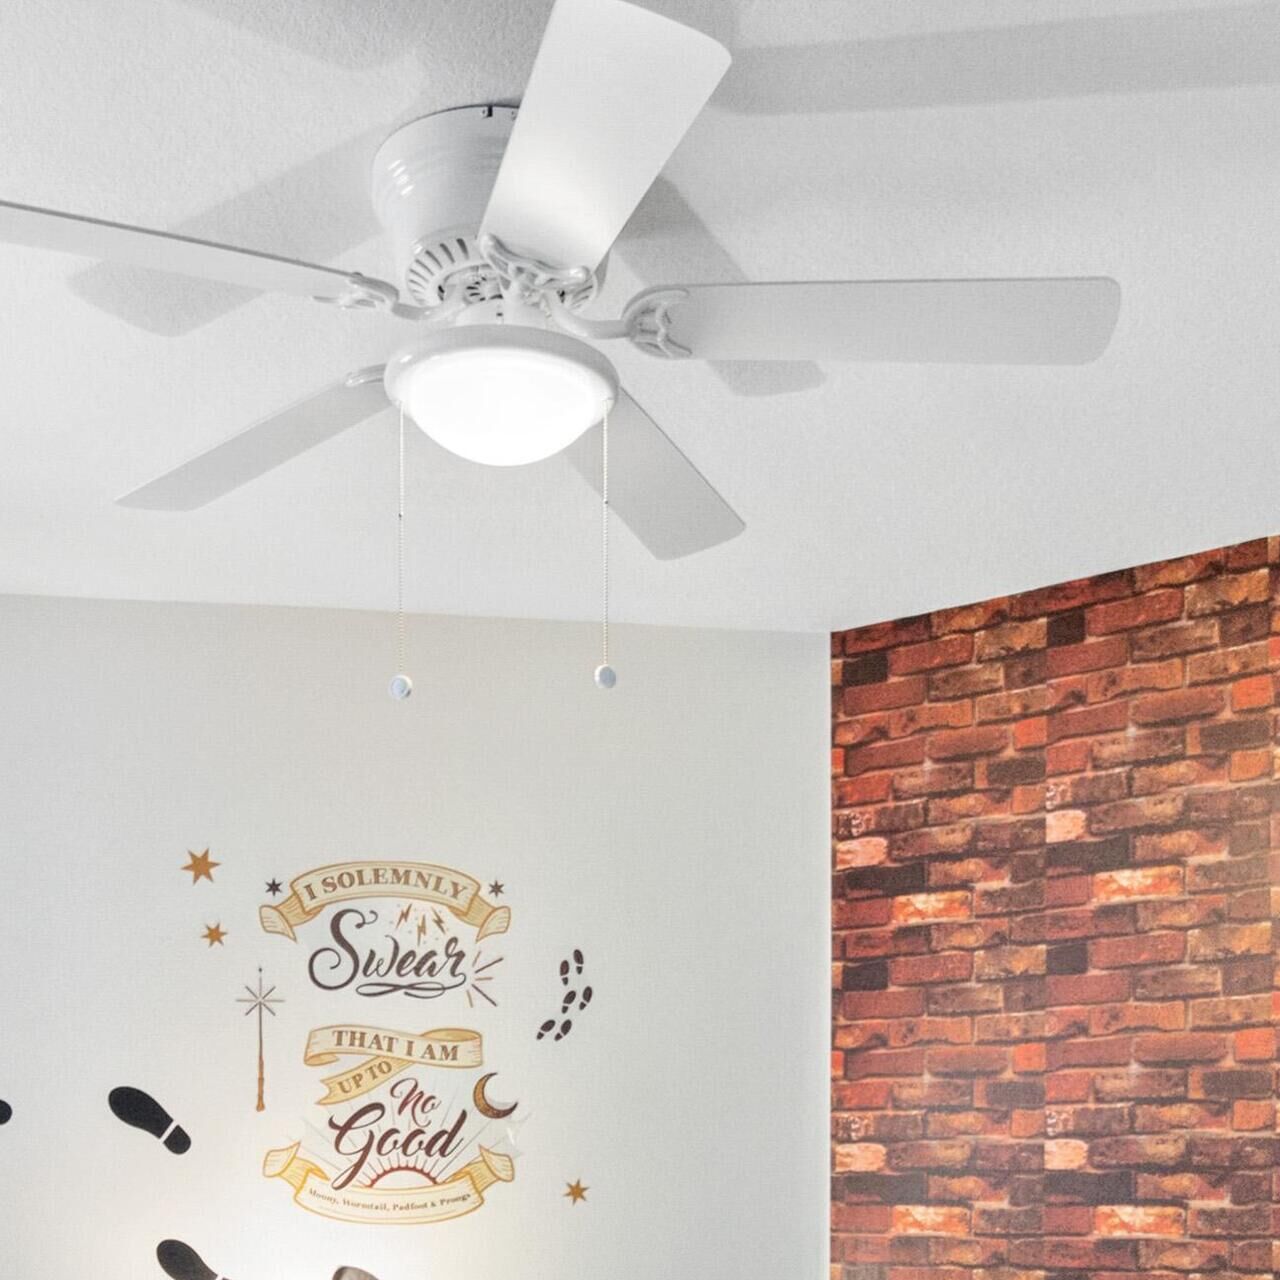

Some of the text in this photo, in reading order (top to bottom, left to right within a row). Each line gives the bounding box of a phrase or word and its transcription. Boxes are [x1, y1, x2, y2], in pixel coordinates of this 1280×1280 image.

[304, 867, 468, 901] I SOLEMNLY
[308, 908, 467, 999] Swear
[332, 1030, 460, 1062] THAT I AM
[337, 1060, 393, 1094] UP TO
[390, 1077, 442, 1128] No
[328, 1102, 468, 1191] Good
